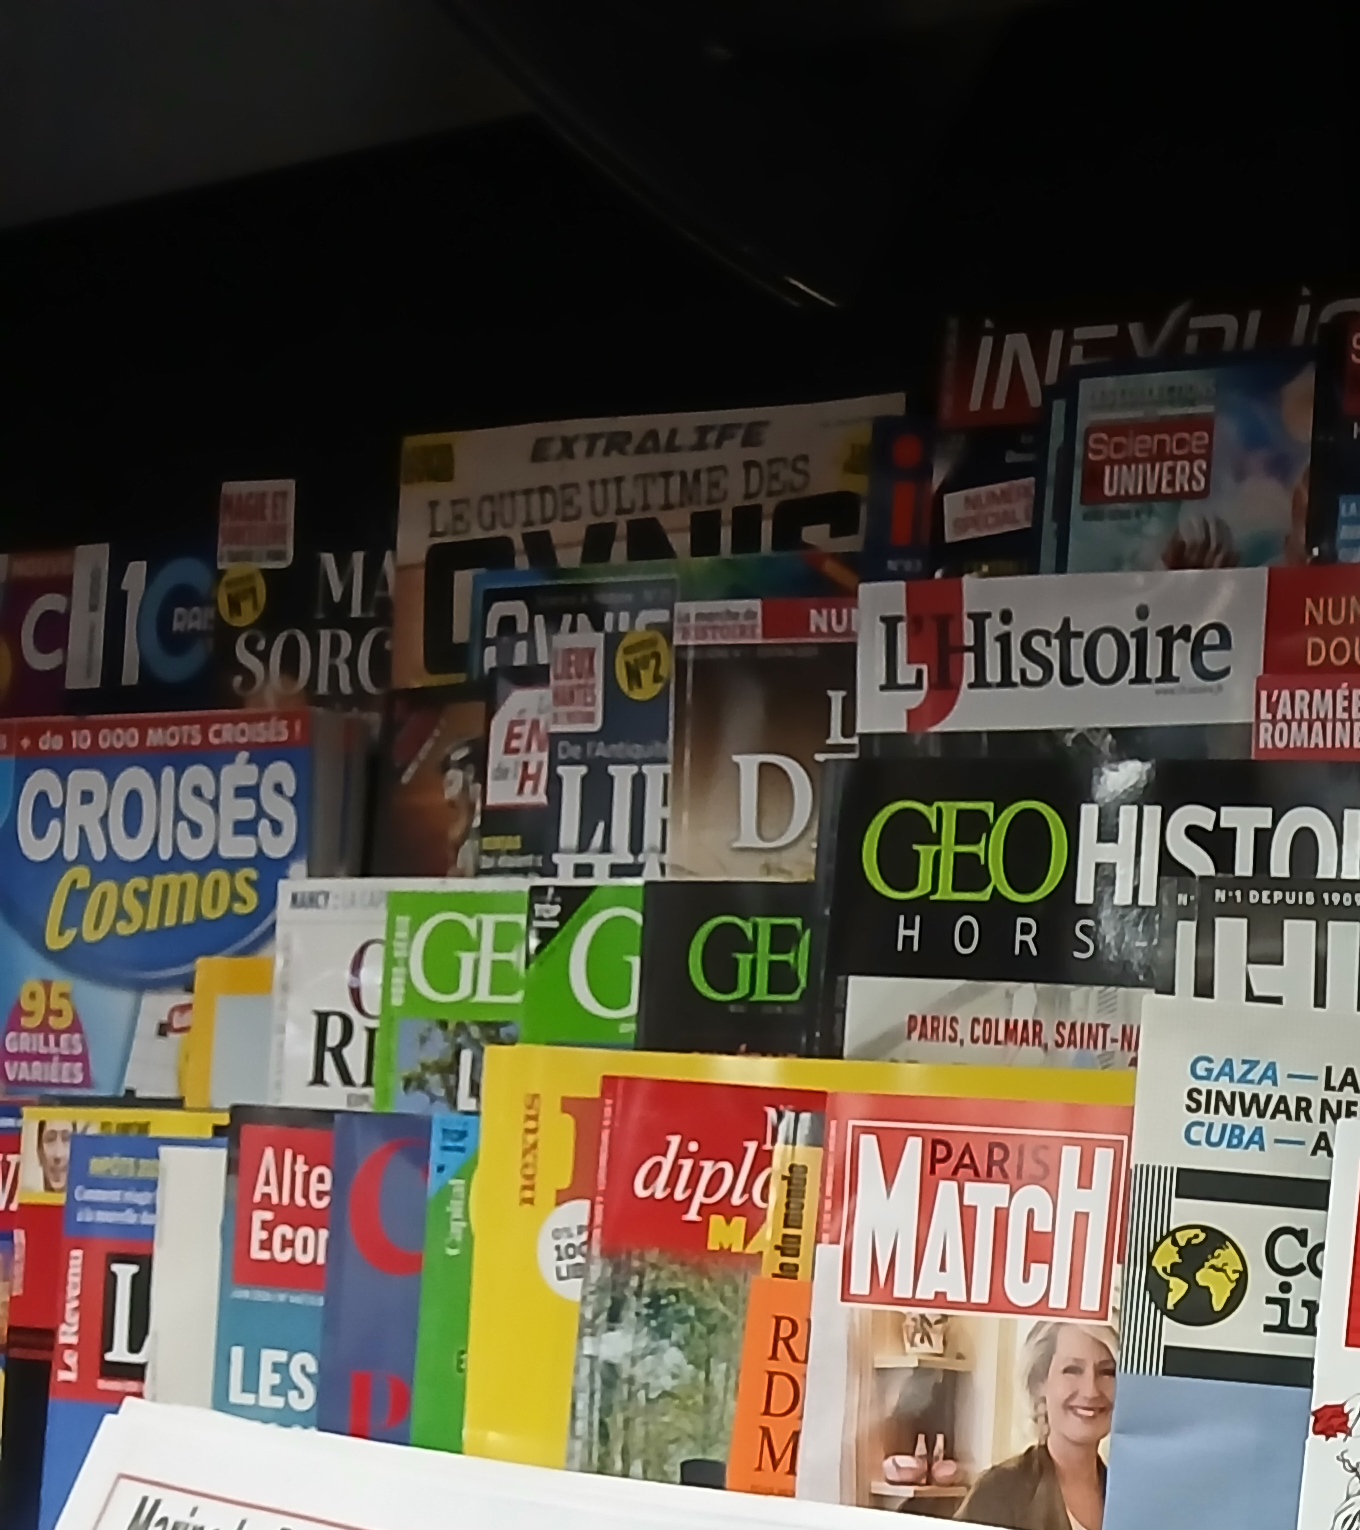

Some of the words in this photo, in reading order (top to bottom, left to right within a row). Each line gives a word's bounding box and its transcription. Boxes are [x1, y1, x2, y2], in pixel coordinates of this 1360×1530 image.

[530, 420, 770, 463] EXTRALIFE
[429, 499, 471, 538] LE
[477, 482, 582, 532] GUIDE
[590, 462, 728, 518] ULTIME
[744, 454, 810, 498] DES
[878, 603, 1233, 692] L'Histoire
[72, 731, 92, 749] 10
[100, 728, 138, 748] 000
[146, 725, 201, 747] MOTS
[208, 717, 288, 744] CROISÉS
[17, 752, 297, 861] CROISÉS
[861, 800, 1069, 903] GEO
[46, 866, 258, 948] Cosmos
[19, 981, 73, 1029] 95
[4, 1032, 83, 1053] GRILLES
[906, 1014, 965, 1049] PARIS,
[970, 1017, 1048, 1053] COLMAR,
[4, 1059, 83, 1085] VARIÉES
[1190, 1055, 1281, 1086] GAZA
[1324, 1064, 1360, 1092] LA
[1185, 1088, 1314, 1124] SINWAR
[520, 1093, 541, 1206] nexus
[929, 1138, 1051, 1180] PARIS
[850, 1133, 1114, 1312] MATCH
